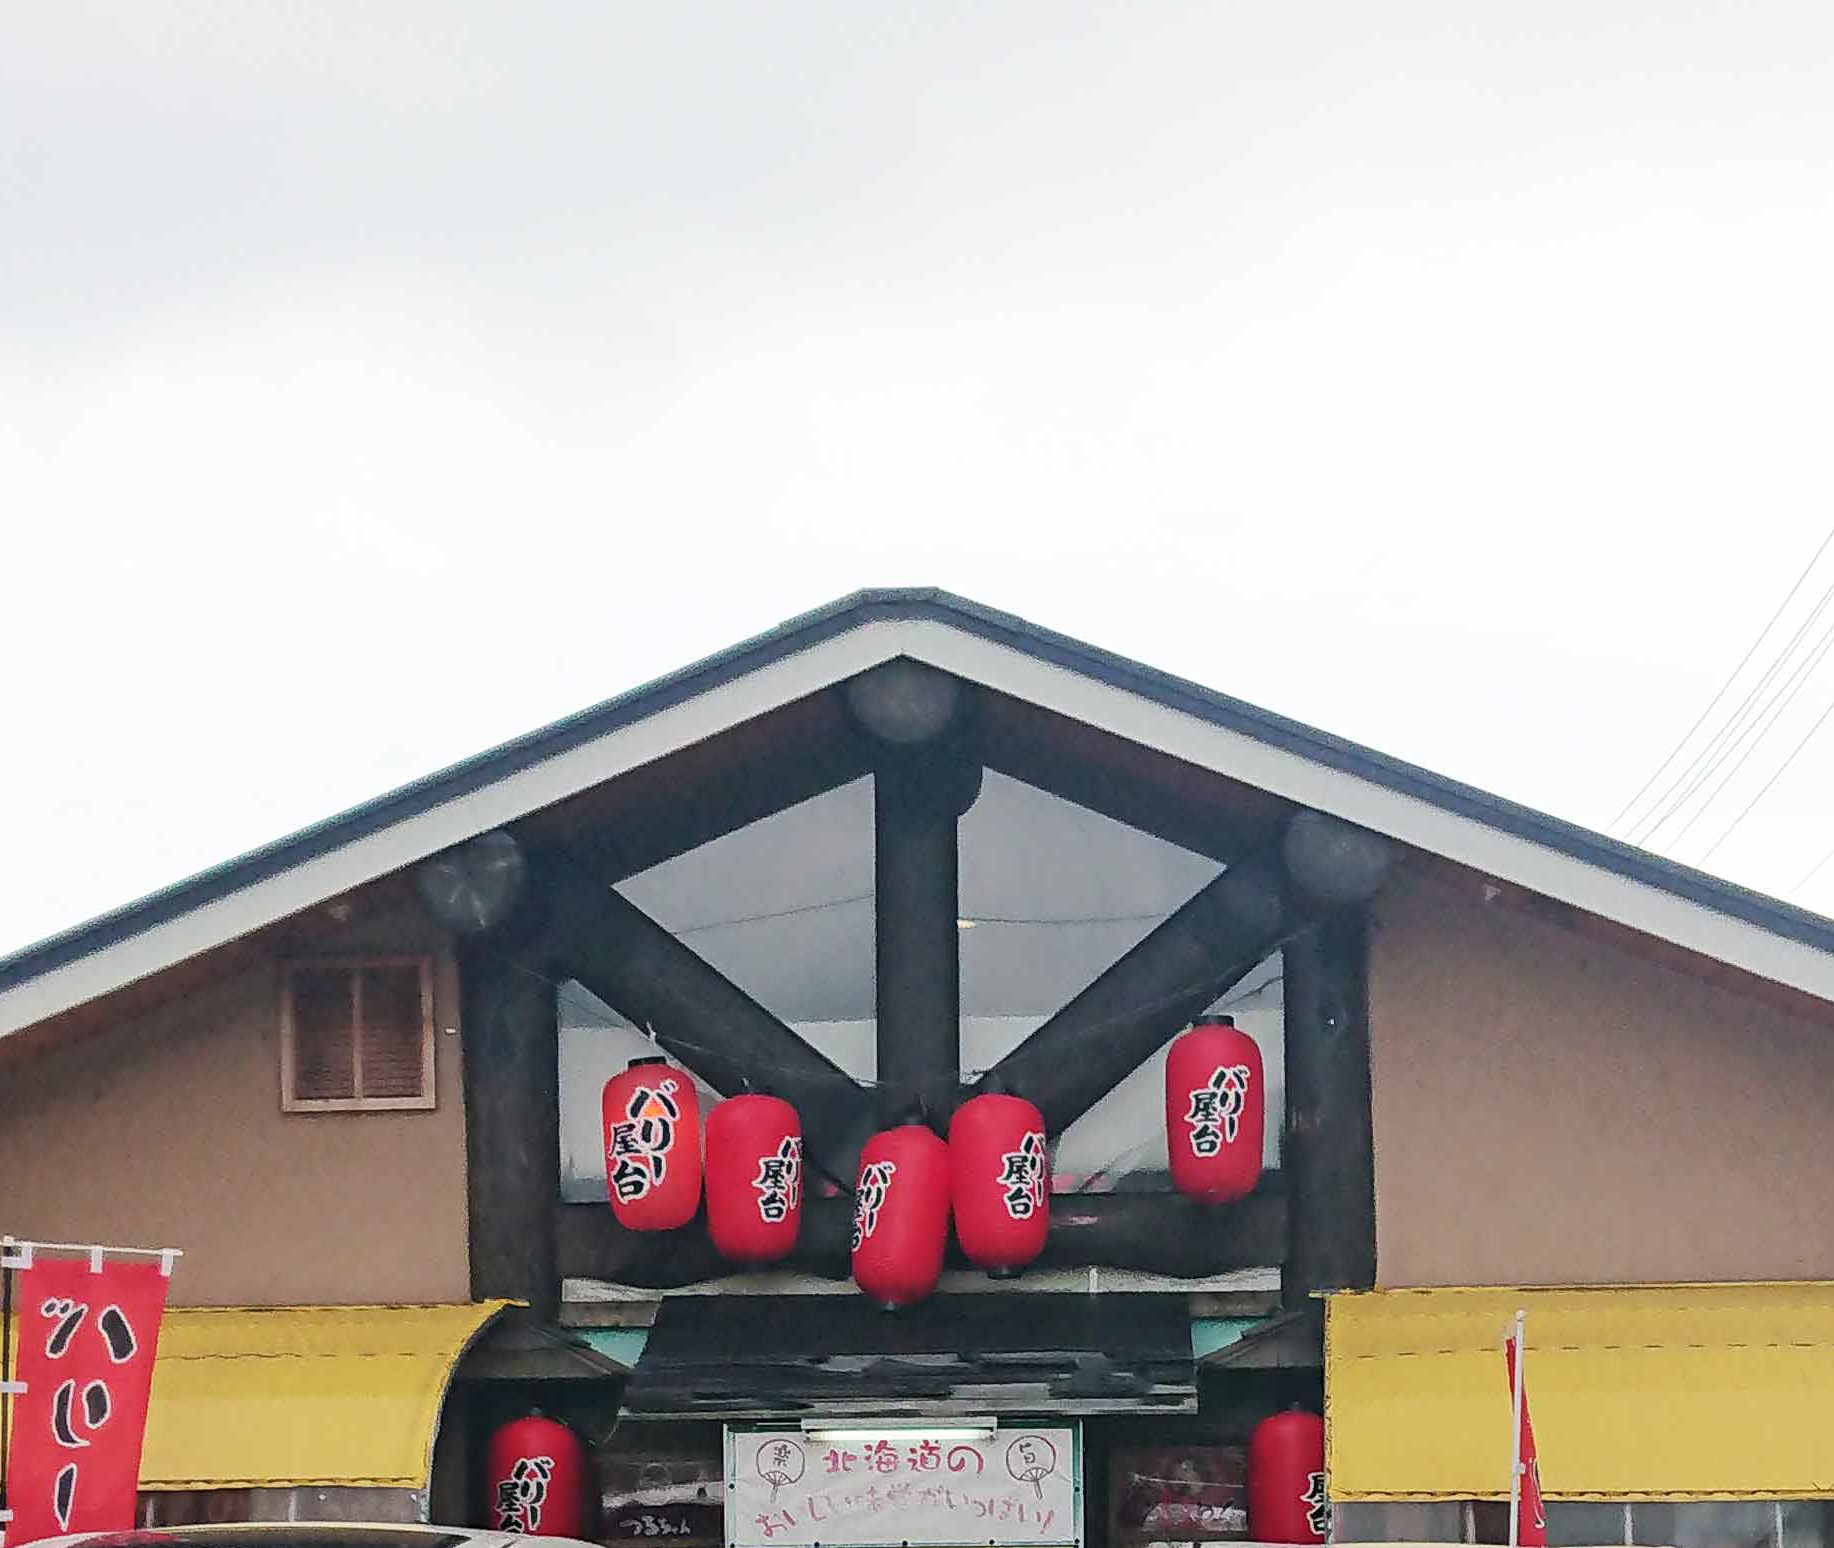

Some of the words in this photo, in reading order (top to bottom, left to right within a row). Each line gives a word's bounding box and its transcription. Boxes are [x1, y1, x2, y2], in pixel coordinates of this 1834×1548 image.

[626, 1078, 680, 1186] バリー
[1183, 1088, 1223, 1158] 屋台
[1208, 1065, 1251, 1143] バリー
[608, 1121, 652, 1205] 屋台
[751, 1157, 789, 1223] 屋台
[860, 1161, 896, 1238] バリー
[996, 1152, 1036, 1220] 屋台
[512, 1456, 555, 1531] バリー
[822, 1440, 984, 1474] 北海道の
